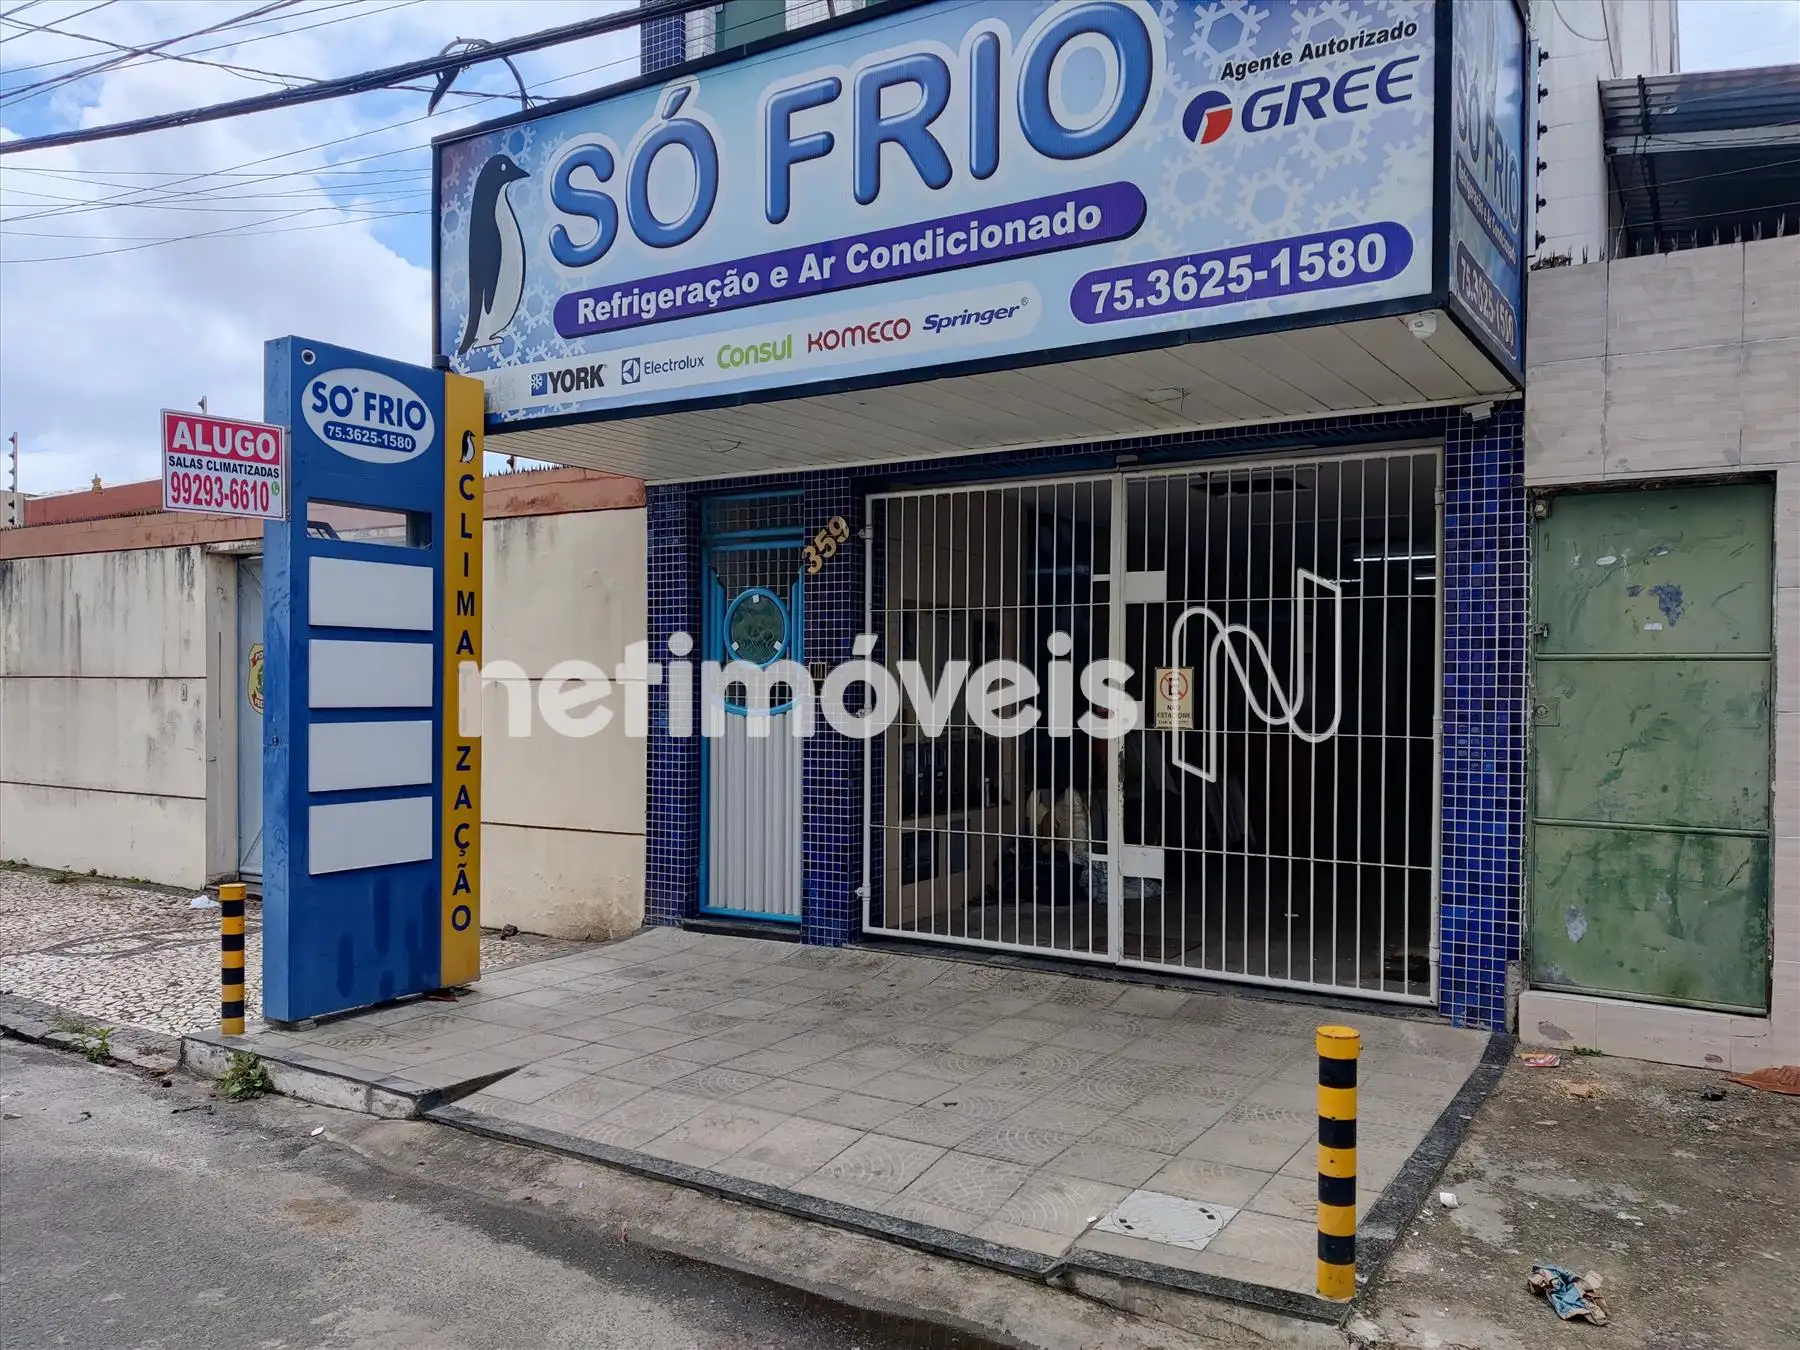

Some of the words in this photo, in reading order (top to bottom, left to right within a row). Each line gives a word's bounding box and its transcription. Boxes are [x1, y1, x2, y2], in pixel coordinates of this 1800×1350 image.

[1220, 52, 1293, 82] Agente
[1299, 20, 1417, 62] Autorizado
[1241, 55, 1420, 133] GREE
[548, 85, 719, 268] SÓ
[765, 3, 1153, 225] FRIO
[577, 271, 760, 325] Refrigeração
[770, 263, 788, 289] e
[799, 251, 837, 283] Ar
[845, 200, 1102, 275] Condicionado
[1090, 232, 1388, 315] 75.3625-1580
[547, 363, 605, 394] YORK
[643, 354, 705, 376] Electrolux
[717, 334, 792, 370] Consul
[807, 317, 912, 353] KOMECO
[172, 421, 277, 460] ALUGO
[327, 425, 413, 450] 75.3625-1580
[363, 391, 427, 431] FRIO
[168, 455, 204, 470] SALAS
[206, 460, 280, 479] CLIMATIZADAS
[170, 472, 270, 512] 99293-6610
[802, 516, 849, 574] 359
